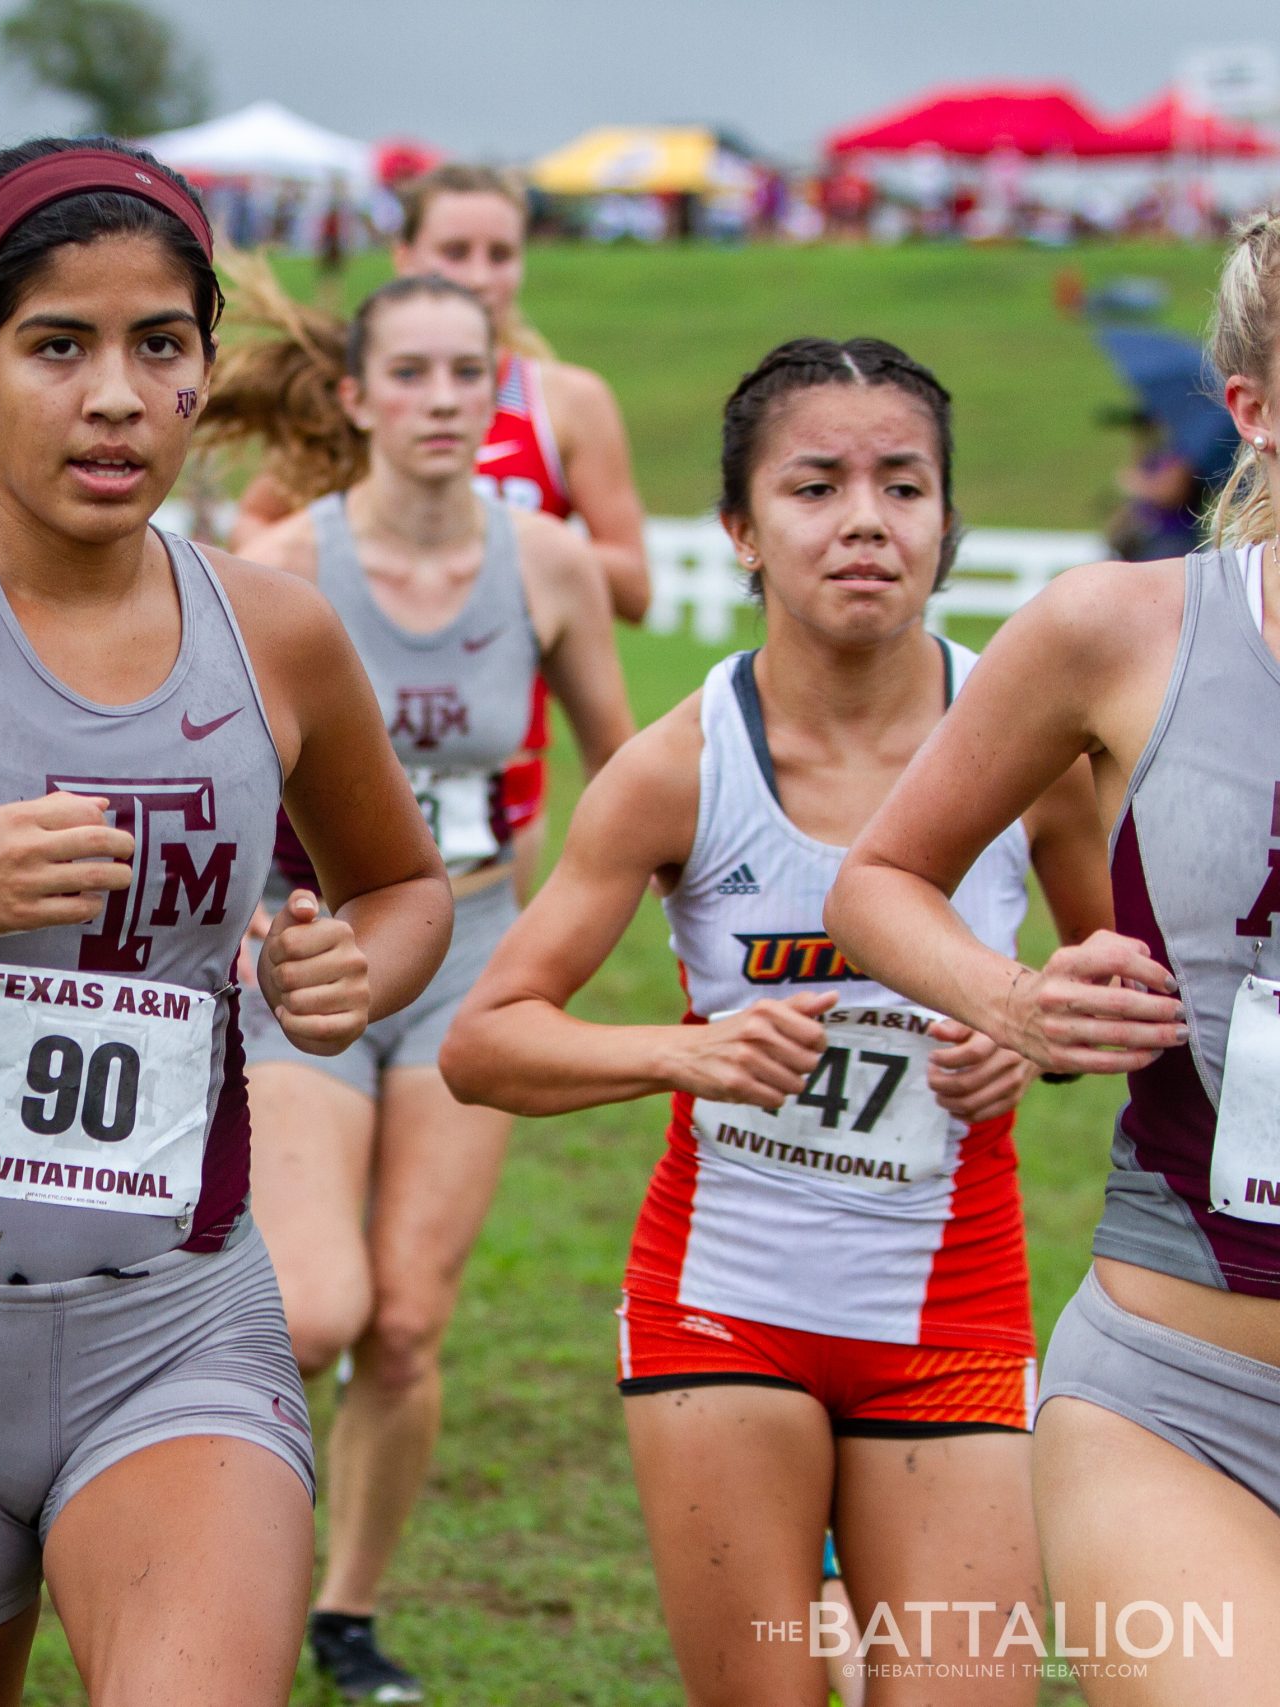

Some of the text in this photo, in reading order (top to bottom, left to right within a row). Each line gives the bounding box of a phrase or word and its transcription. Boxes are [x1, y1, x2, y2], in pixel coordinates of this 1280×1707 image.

[718, 884, 761, 895] adidas
[113, 987, 191, 1021] A&M
[20, 1034, 141, 1143] 90
[762, 1045, 910, 1134] 47
[716, 1122, 911, 1183] INVITATIONAL
